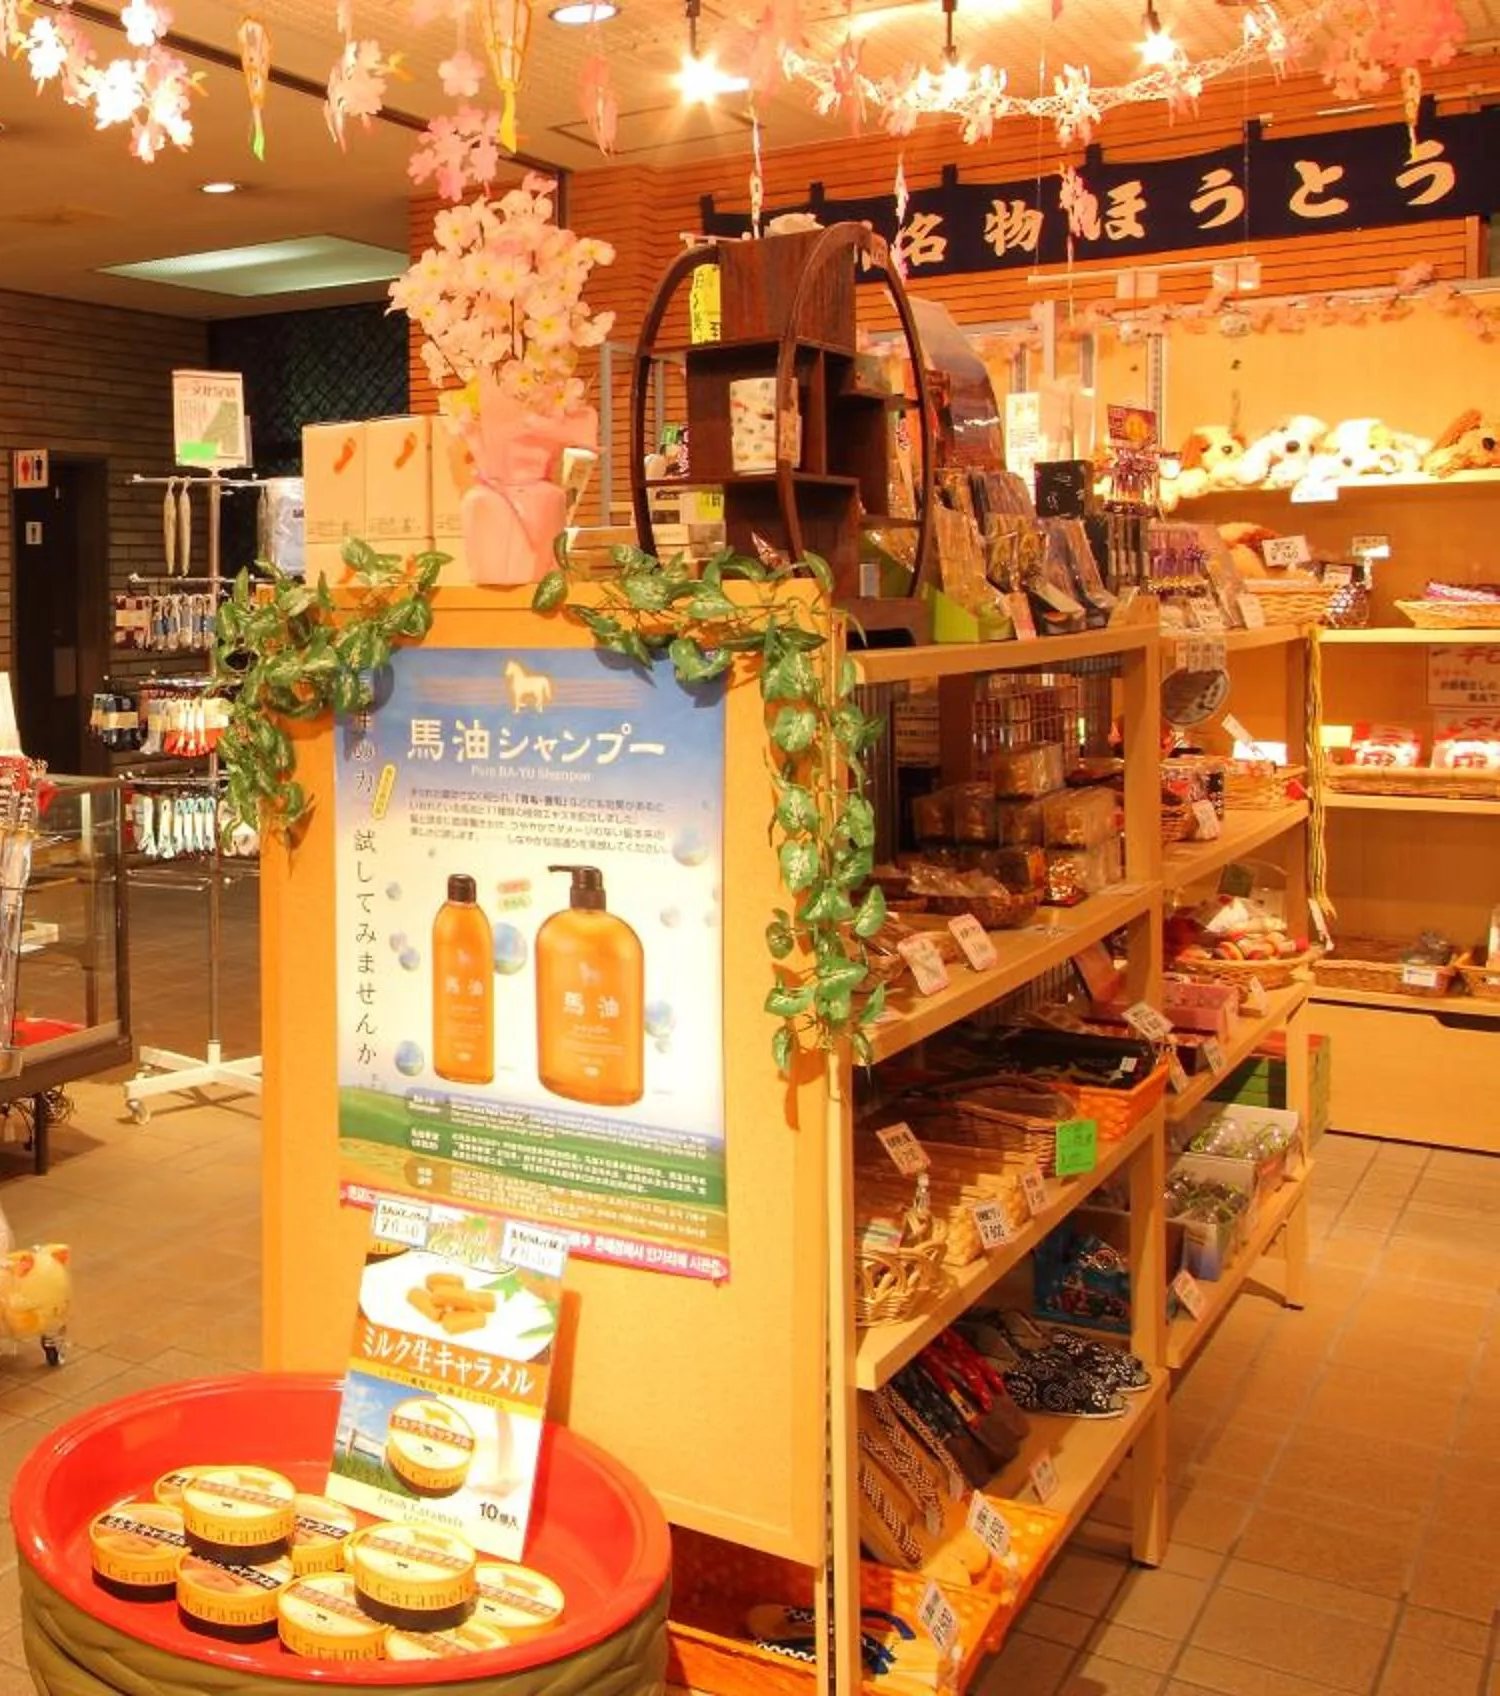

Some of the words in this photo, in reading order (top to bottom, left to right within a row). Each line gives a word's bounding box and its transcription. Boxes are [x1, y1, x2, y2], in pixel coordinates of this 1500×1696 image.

[406, 717, 667, 766] 馬油シャンプー
[353, 828, 379, 1065] 試してみませんか
[562, 991, 621, 1018] 馬油
[362, 1325, 536, 1396] ミルク生キャラメル
[202, 1520, 293, 1543] Caramels
[374, 1578, 473, 1608] Caramels
